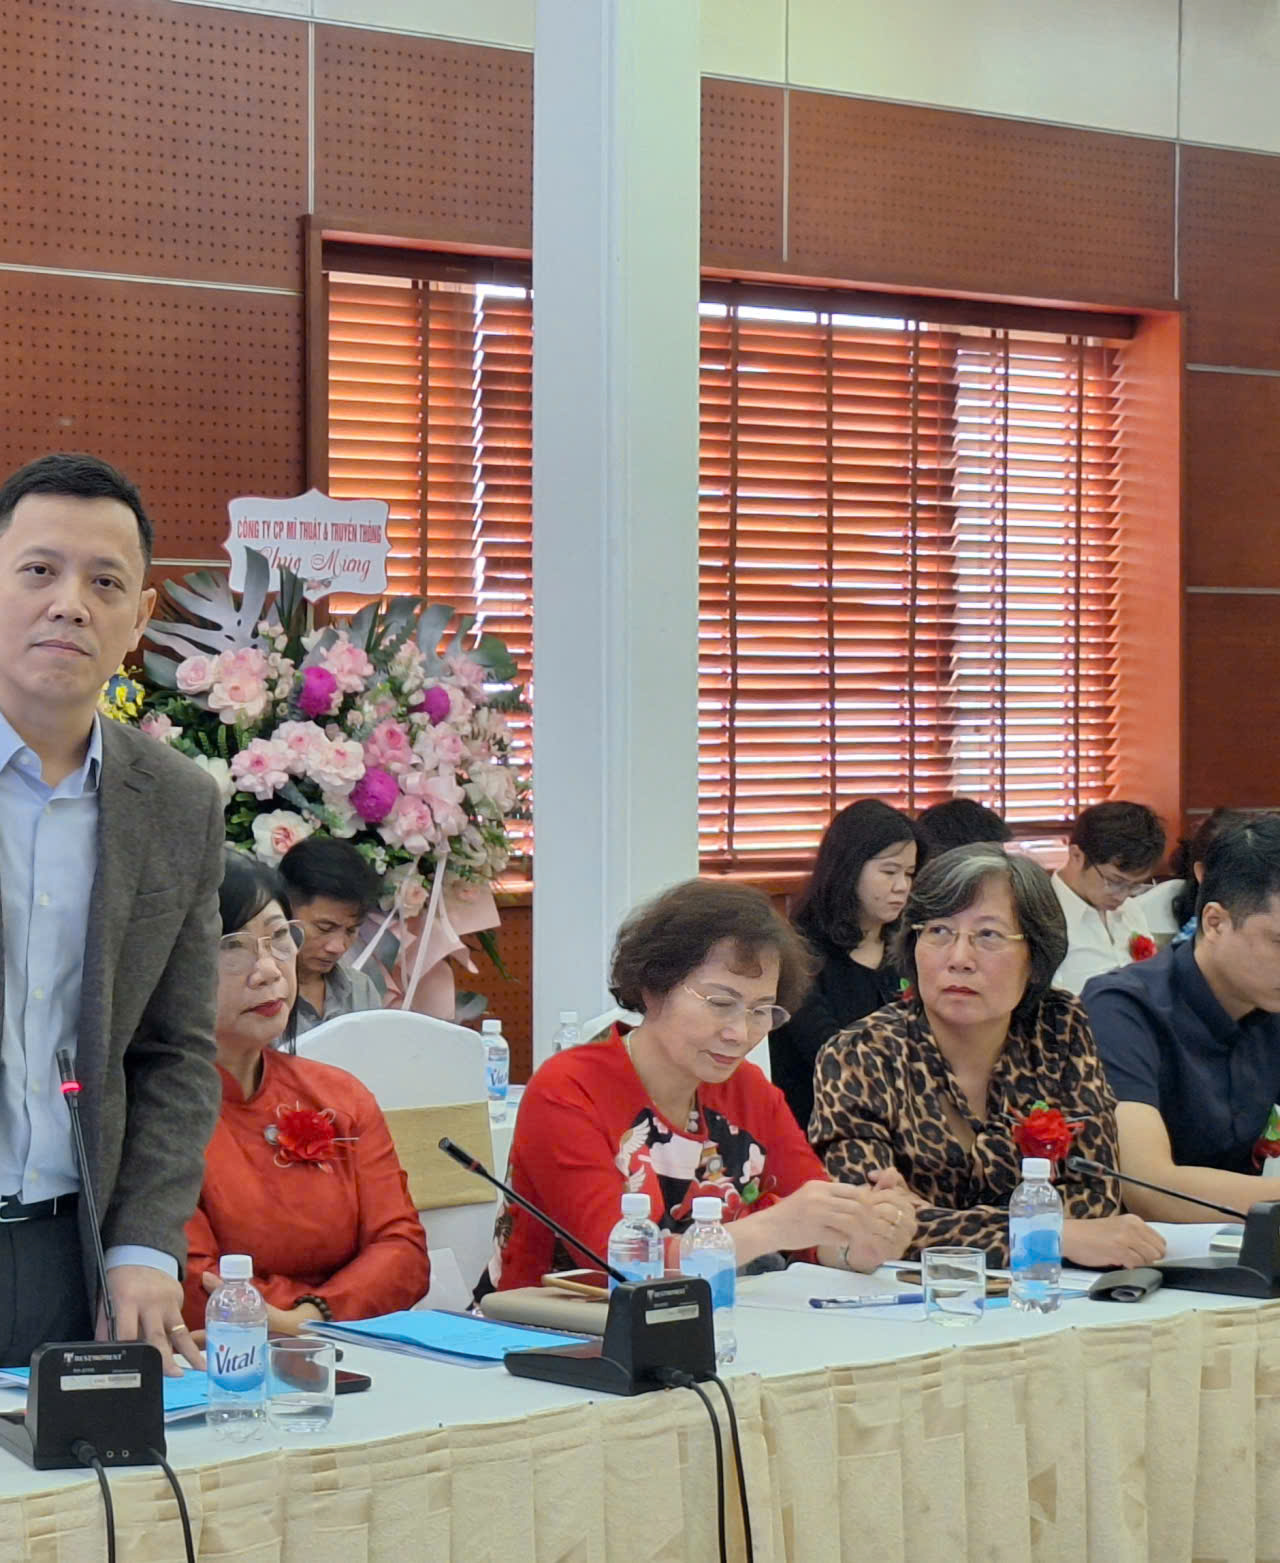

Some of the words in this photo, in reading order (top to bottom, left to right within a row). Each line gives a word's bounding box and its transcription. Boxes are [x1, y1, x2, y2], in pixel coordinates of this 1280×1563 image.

[237, 516, 260, 540] CÔNG
[262, 520, 272, 540] TY
[273, 520, 284, 540] CP
[215, 1345, 256, 1375] Vital
